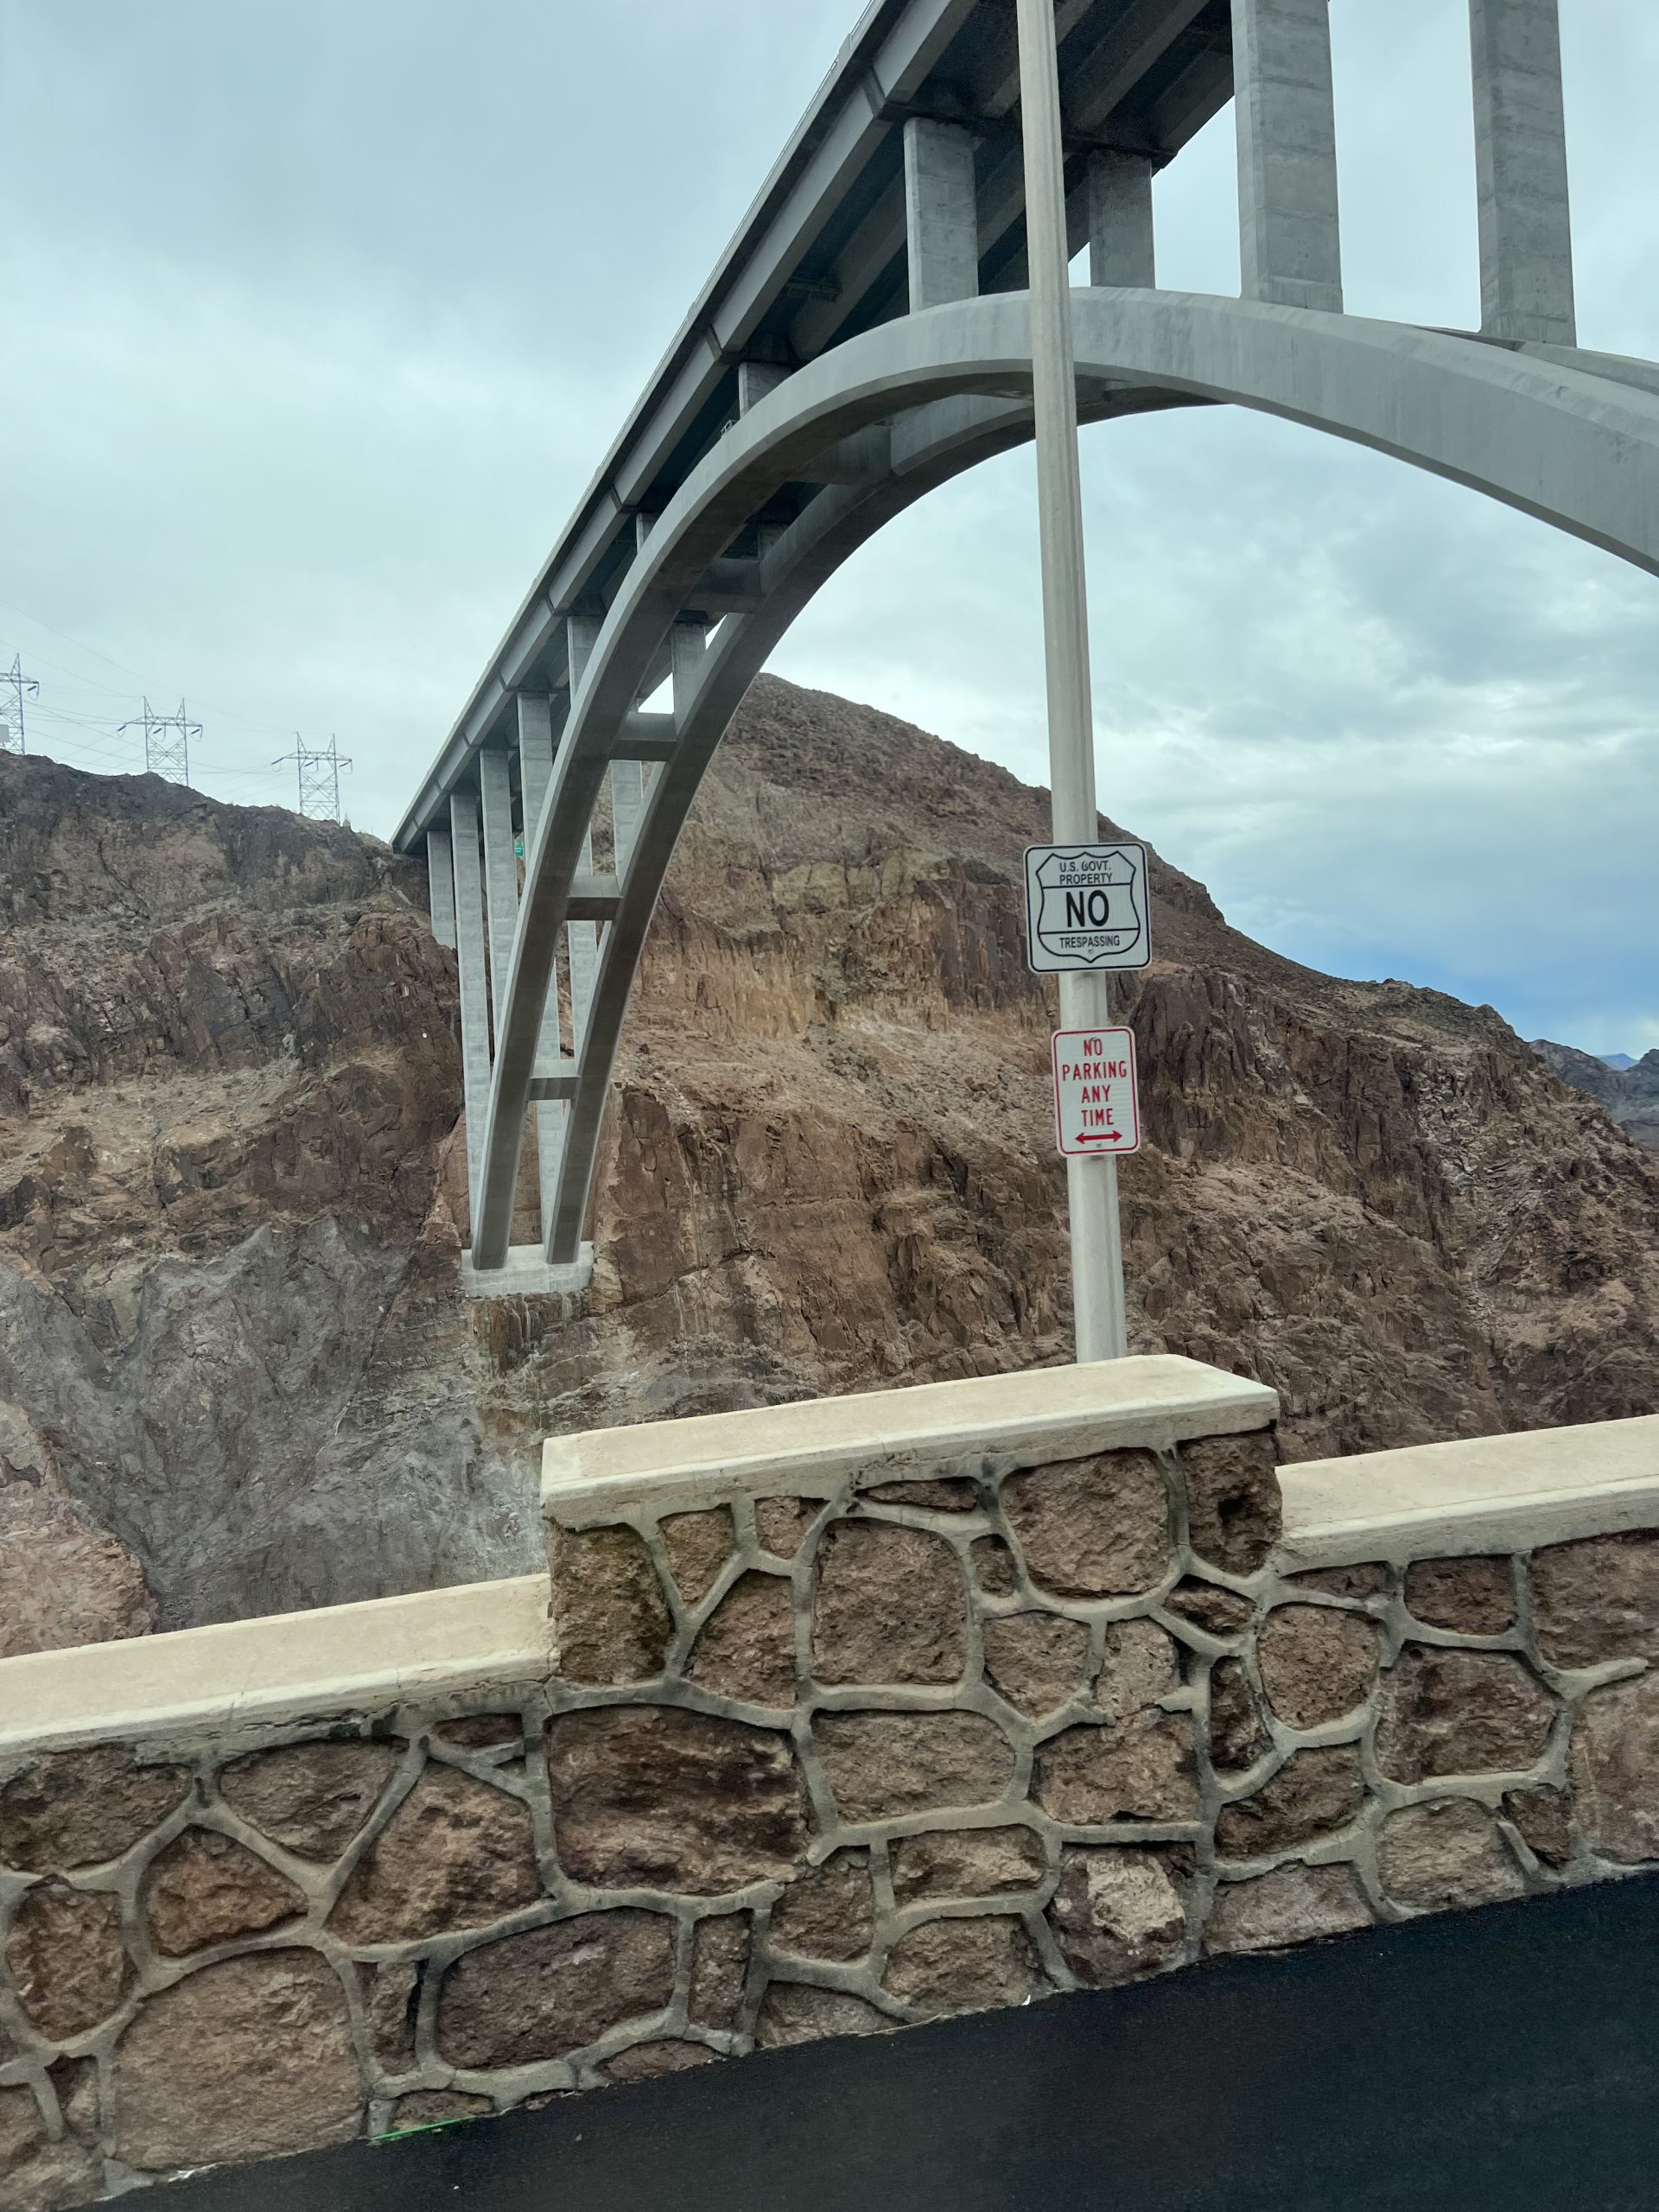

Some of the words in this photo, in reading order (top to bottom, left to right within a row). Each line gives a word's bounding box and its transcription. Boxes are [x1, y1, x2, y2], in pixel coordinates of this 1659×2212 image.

[1059, 873, 1113, 885] PROPERTY
[1065, 889, 1109, 928] NO
[1059, 935, 1121, 949] TRESPASSING
[1084, 1038, 1103, 1057] NO
[1062, 1060, 1128, 1081] PARKING
[1081, 1084, 1111, 1103] ANY
[1081, 1108, 1115, 1127] TIME
